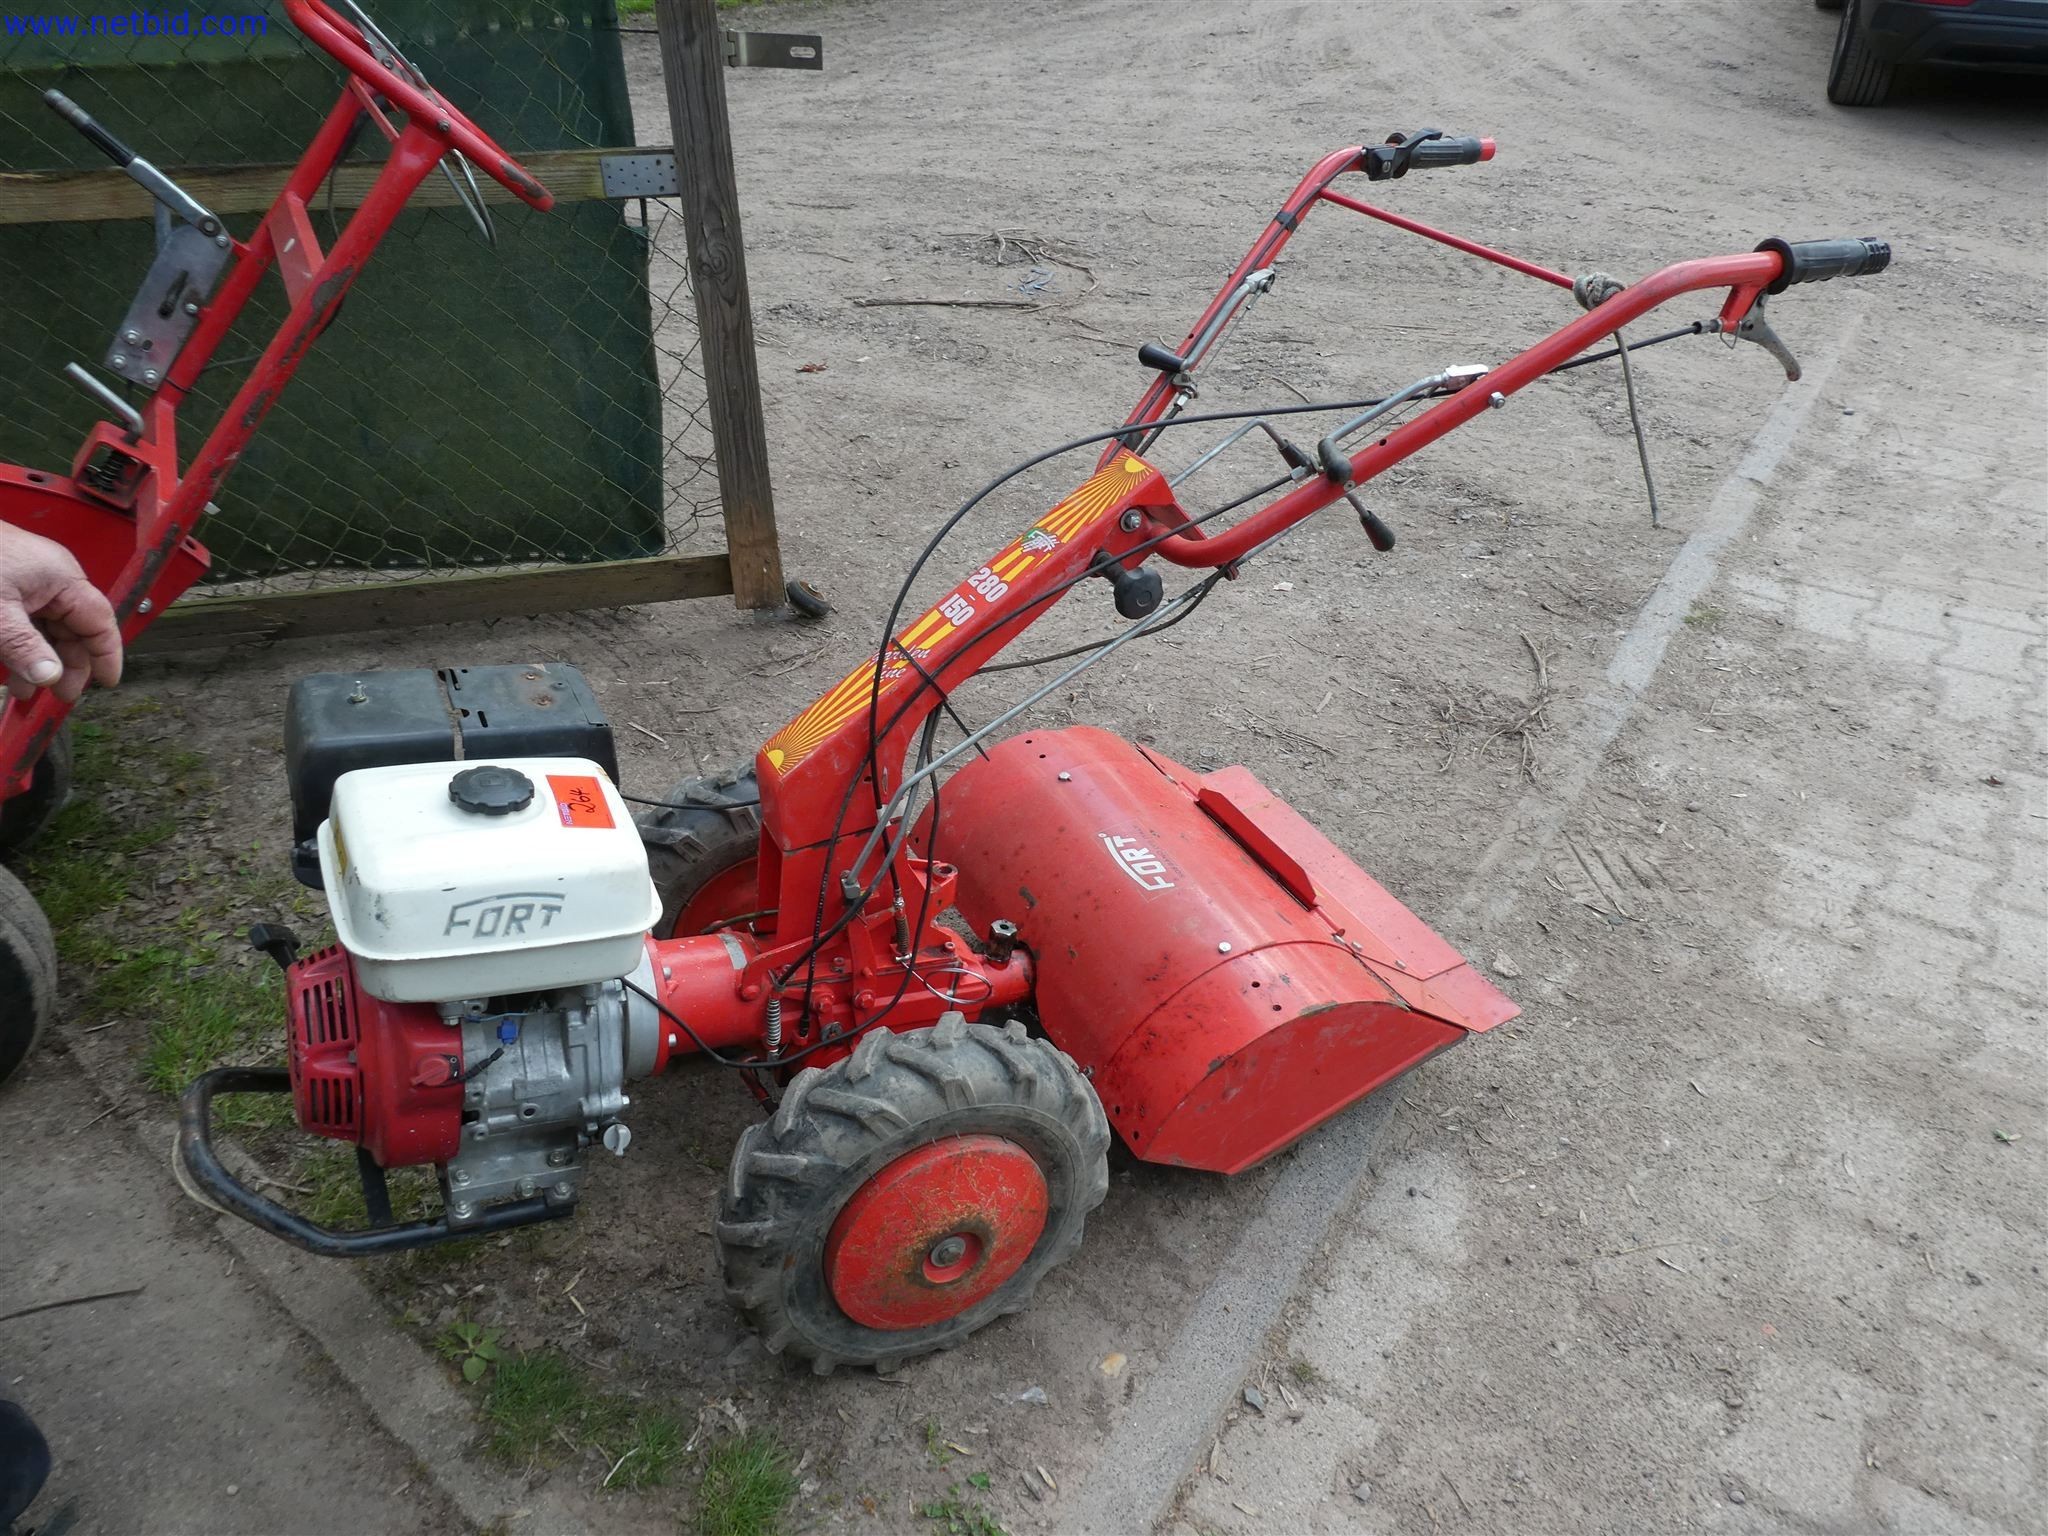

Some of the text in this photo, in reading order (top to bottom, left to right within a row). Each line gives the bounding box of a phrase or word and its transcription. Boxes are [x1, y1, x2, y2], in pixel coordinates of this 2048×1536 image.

[967, 566, 1009, 603] 280
[938, 593, 975, 627] 150
[1102, 835, 1176, 891] FORT
[443, 891, 566, 939] FORT
